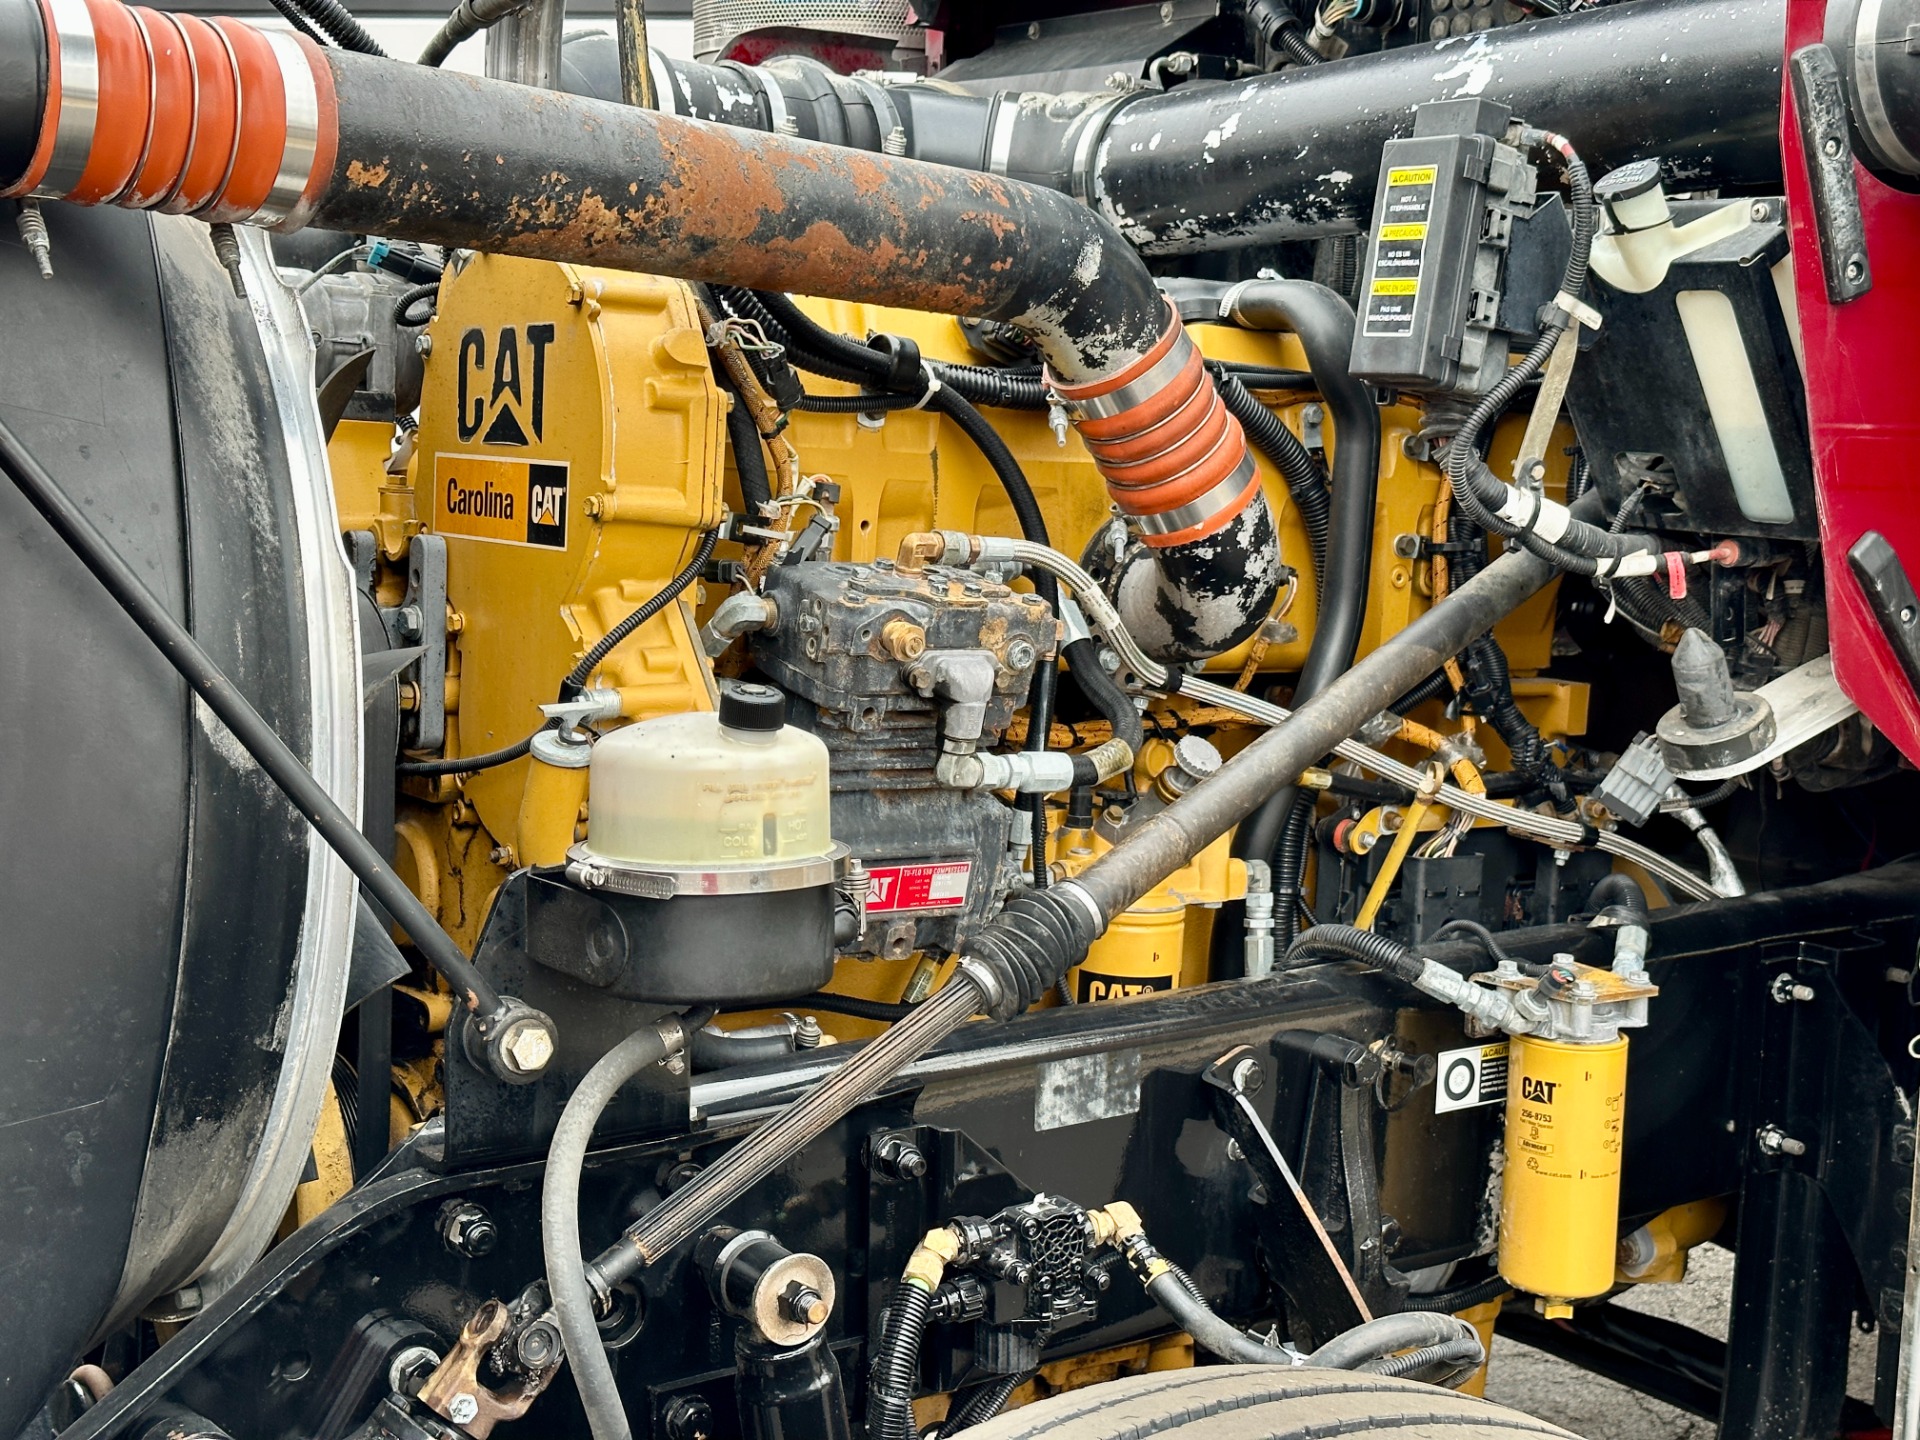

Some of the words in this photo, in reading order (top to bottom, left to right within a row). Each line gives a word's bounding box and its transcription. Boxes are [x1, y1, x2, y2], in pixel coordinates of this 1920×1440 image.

[1399, 172, 1431, 183] CAUTION
[1379, 284, 1392, 293] MISE
[1391, 284, 1399, 292] EN
[1399, 284, 1417, 292] GARDE
[458, 323, 555, 446] CAT
[447, 477, 514, 520] Carolina
[531, 484, 564, 527] CAT
[788, 818, 807, 831] HOT
[866, 877, 893, 902] AT
[1488, 1045, 1509, 1057] CAUT
[1522, 1076, 1557, 1105] CAT
[1521, 1108, 1552, 1123] 256-8753
[1522, 1139, 1547, 1152] Advanced
[1535, 1169, 1572, 1179] www.cat.com
